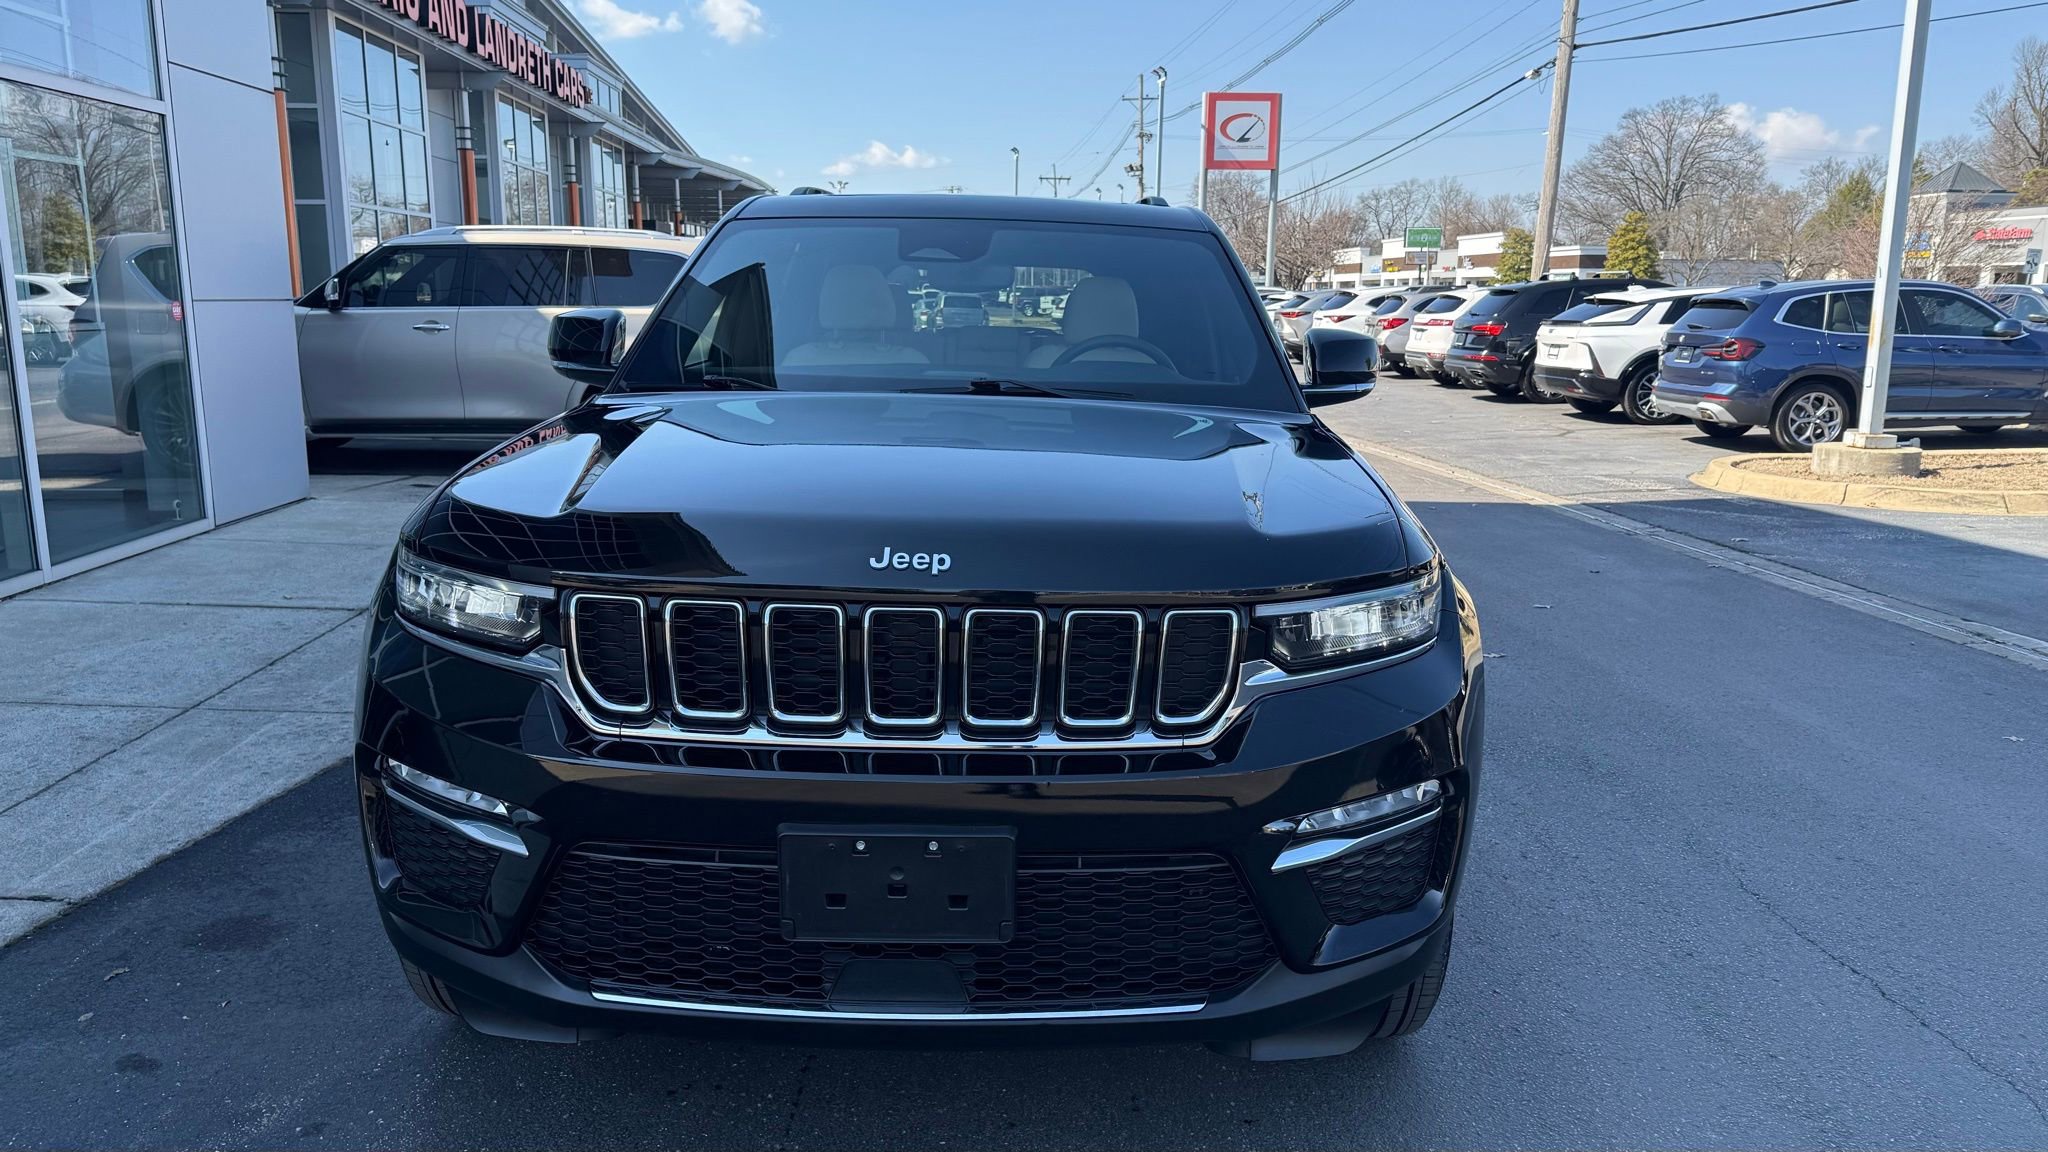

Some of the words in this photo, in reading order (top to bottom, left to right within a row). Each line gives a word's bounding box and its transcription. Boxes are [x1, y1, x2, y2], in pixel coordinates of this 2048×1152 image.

[474, 6, 553, 92] LANDRETH
[555, 58, 586, 109] CARS
[869, 546, 952, 575] Jeep
